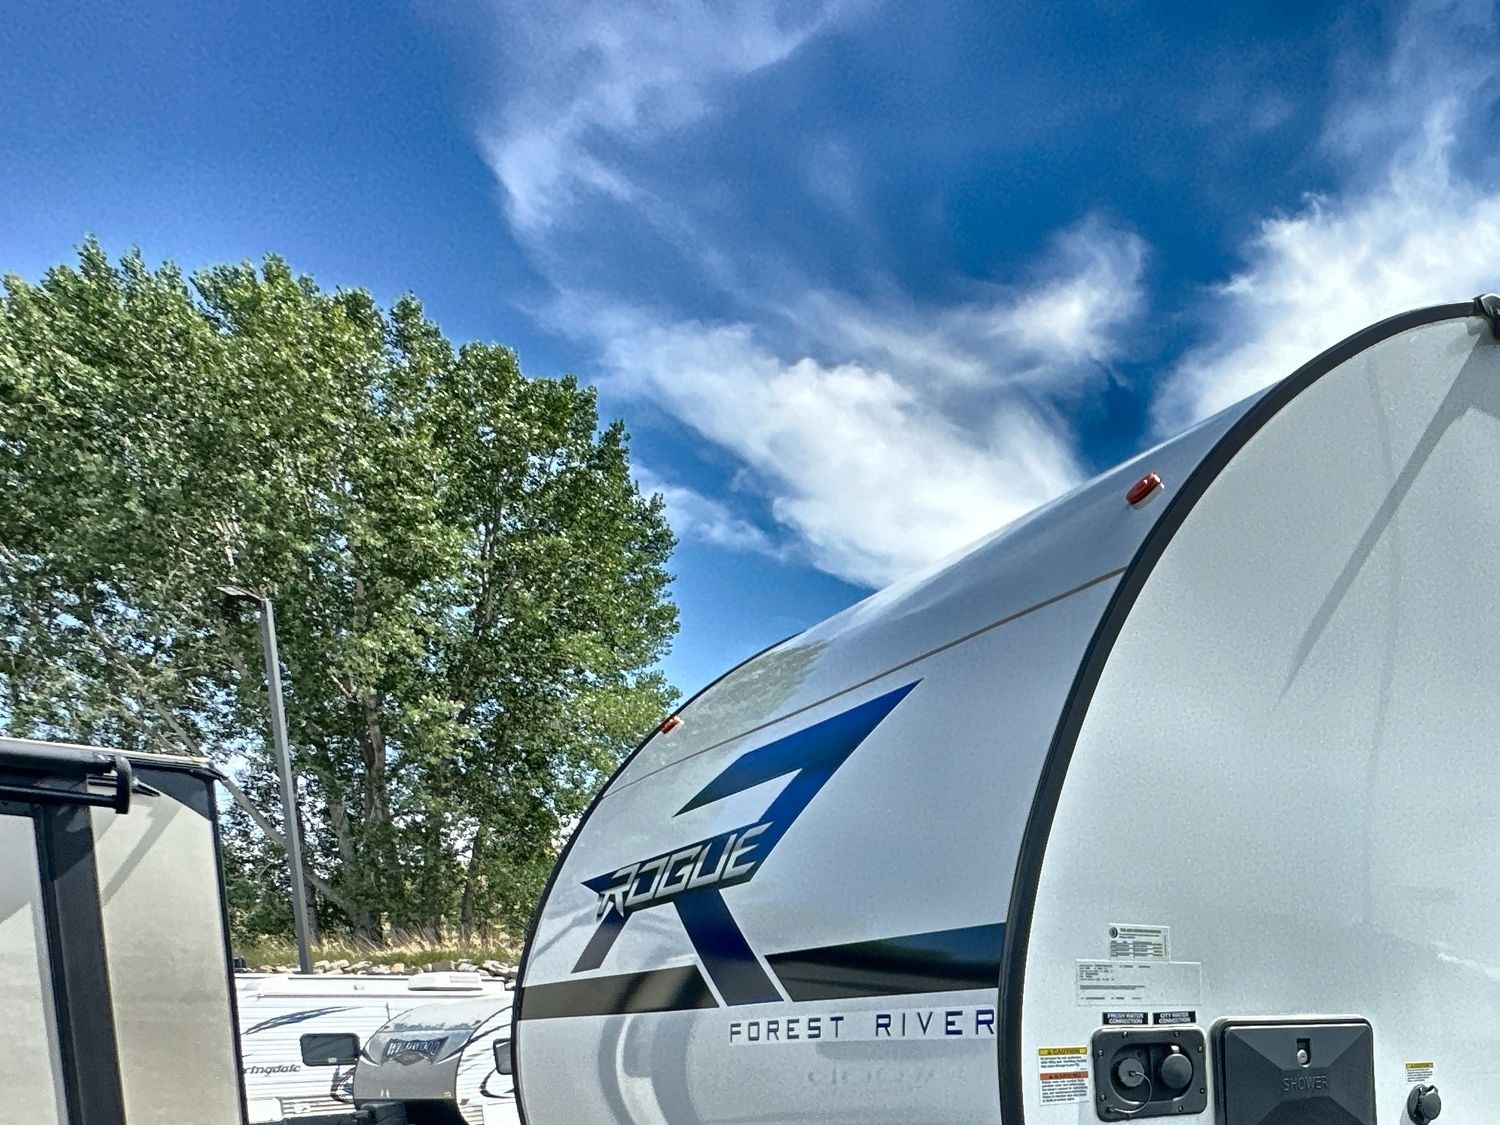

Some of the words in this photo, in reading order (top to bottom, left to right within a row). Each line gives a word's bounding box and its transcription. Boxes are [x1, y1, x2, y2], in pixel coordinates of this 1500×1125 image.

[596, 821, 774, 922] ROGUE
[730, 1016, 844, 1043] FOREST
[875, 1009, 995, 1037] RIVER
[242, 1064, 301, 1077] ringdale
[1282, 1075, 1328, 1092] SHOWER
